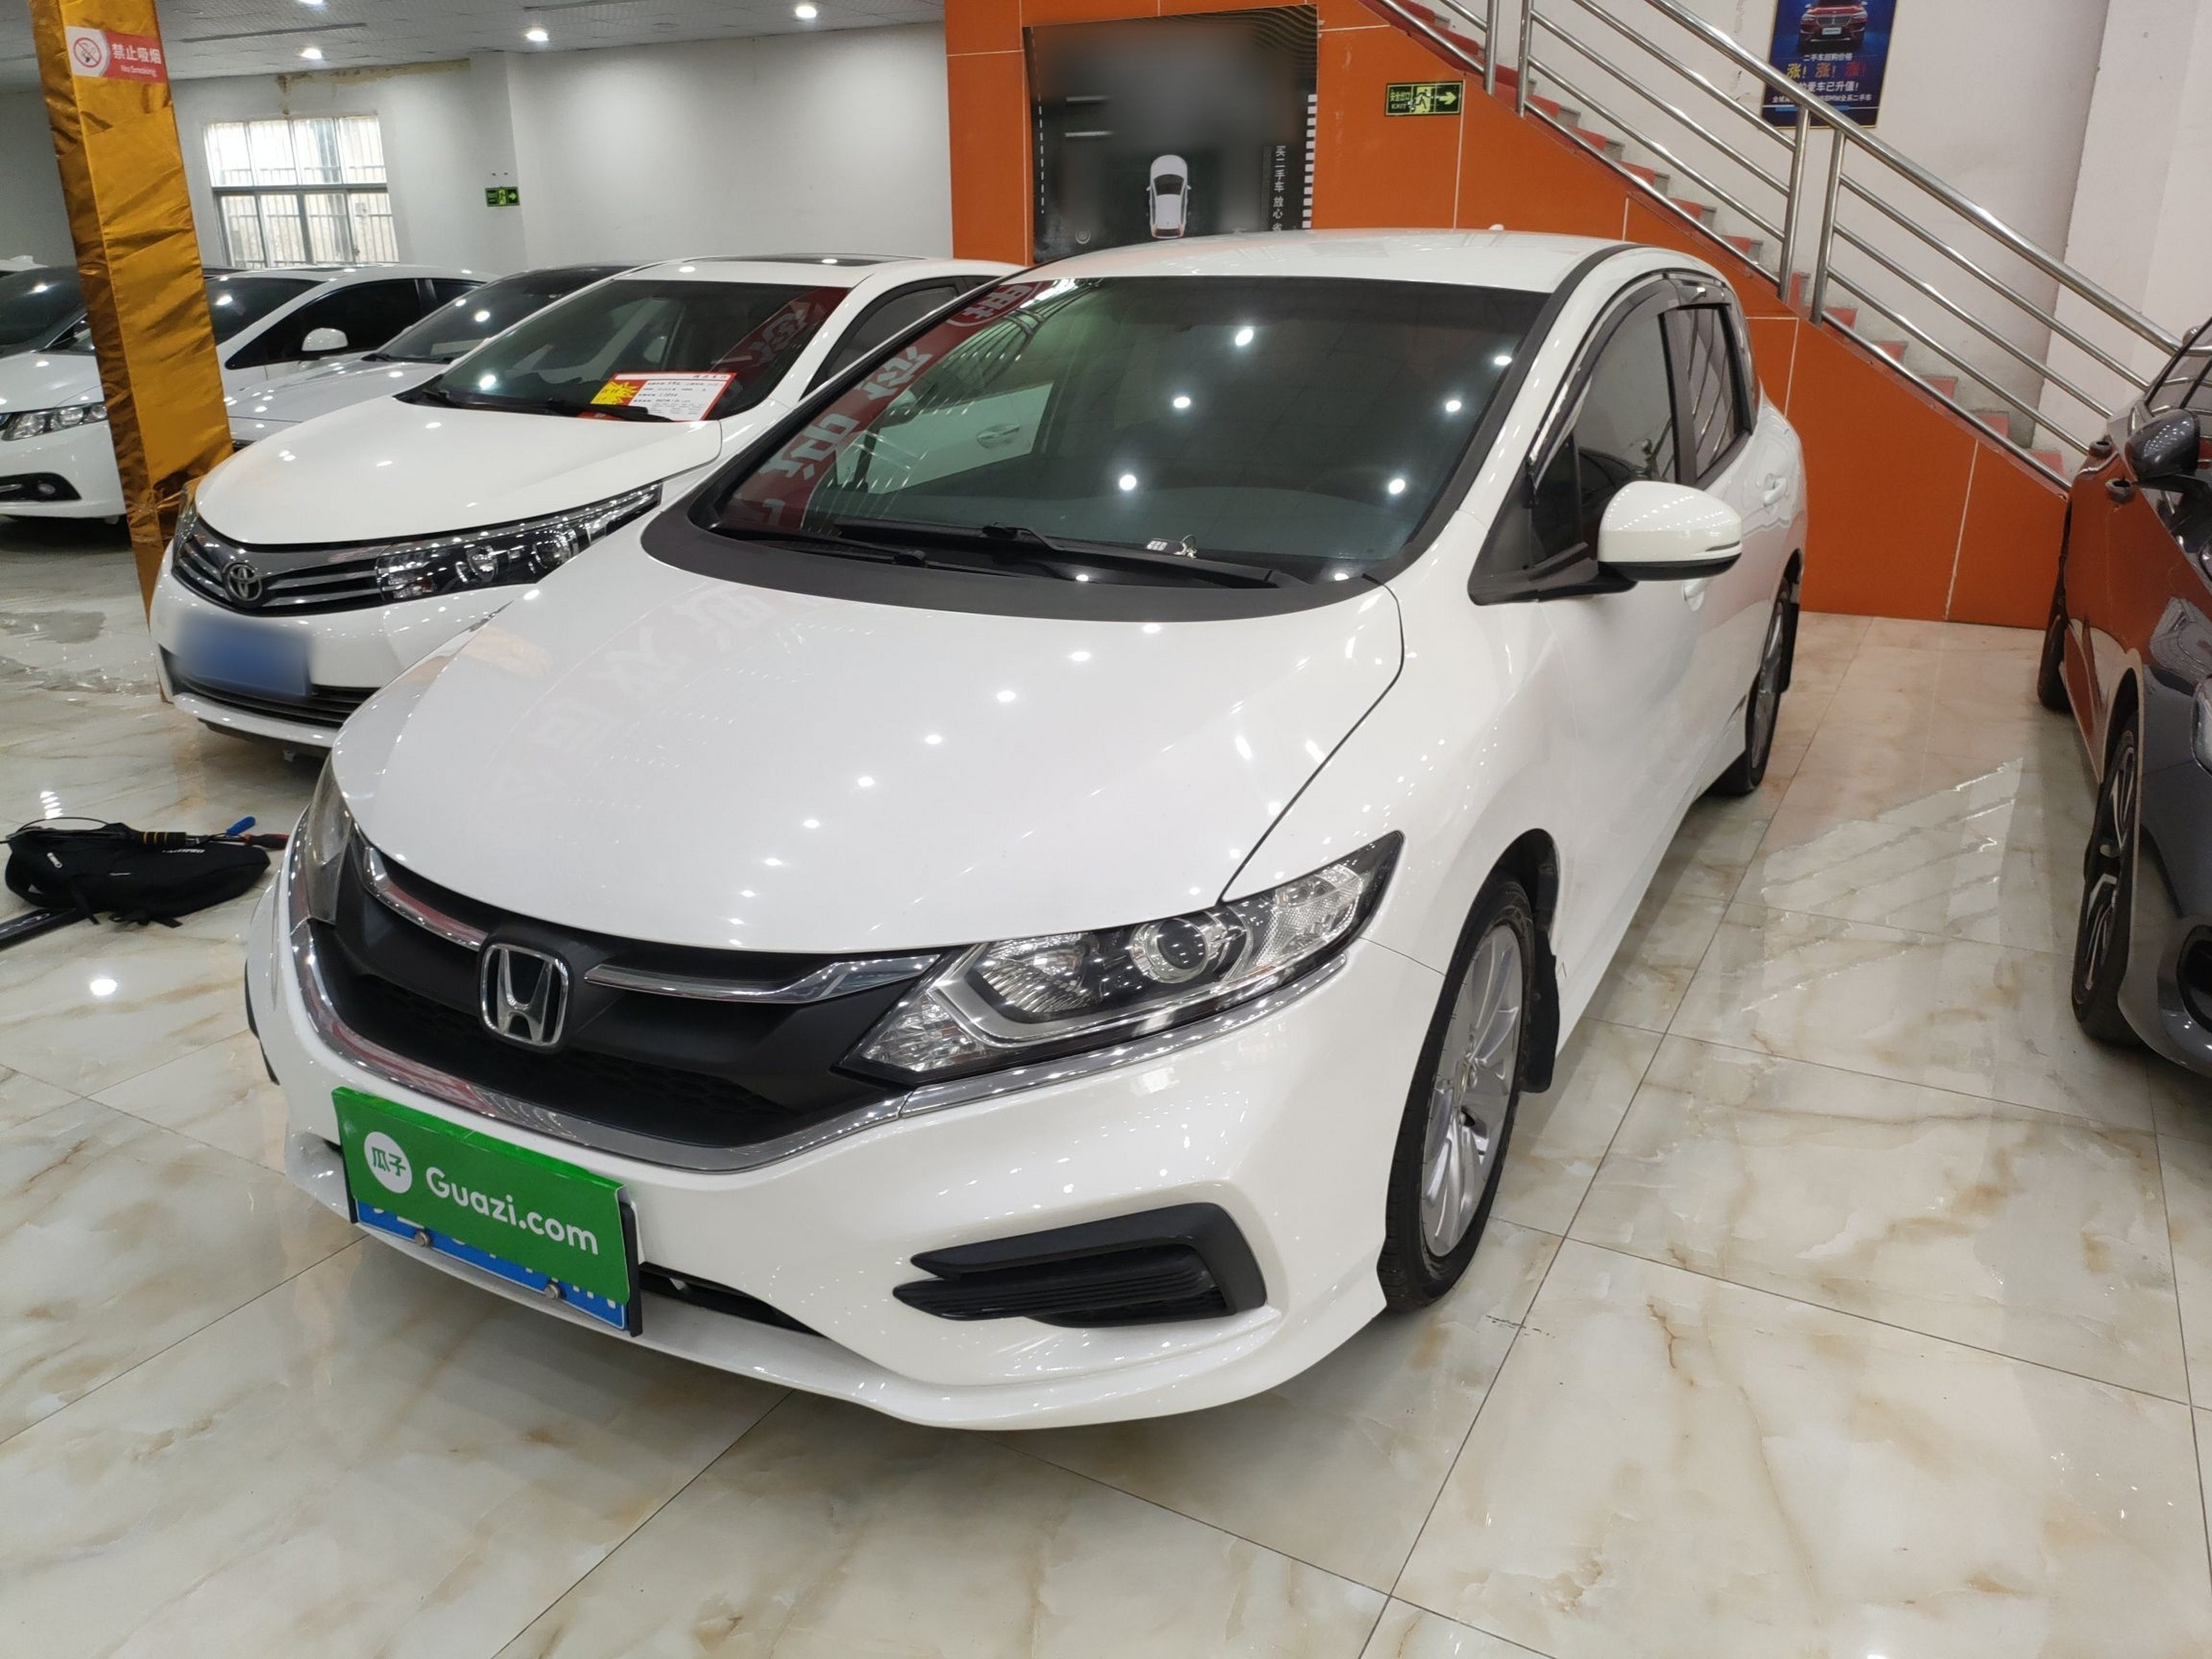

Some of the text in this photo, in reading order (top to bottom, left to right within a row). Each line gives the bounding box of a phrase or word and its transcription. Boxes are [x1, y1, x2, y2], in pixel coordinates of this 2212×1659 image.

[112, 43, 162, 64] 禁止吸烟
[1274, 145, 1286, 192] 买二手车
[1272, 196, 1284, 219] 放心
[372, 1146, 406, 1177] 瓜子
[425, 1166, 600, 1256] Guazi.com
